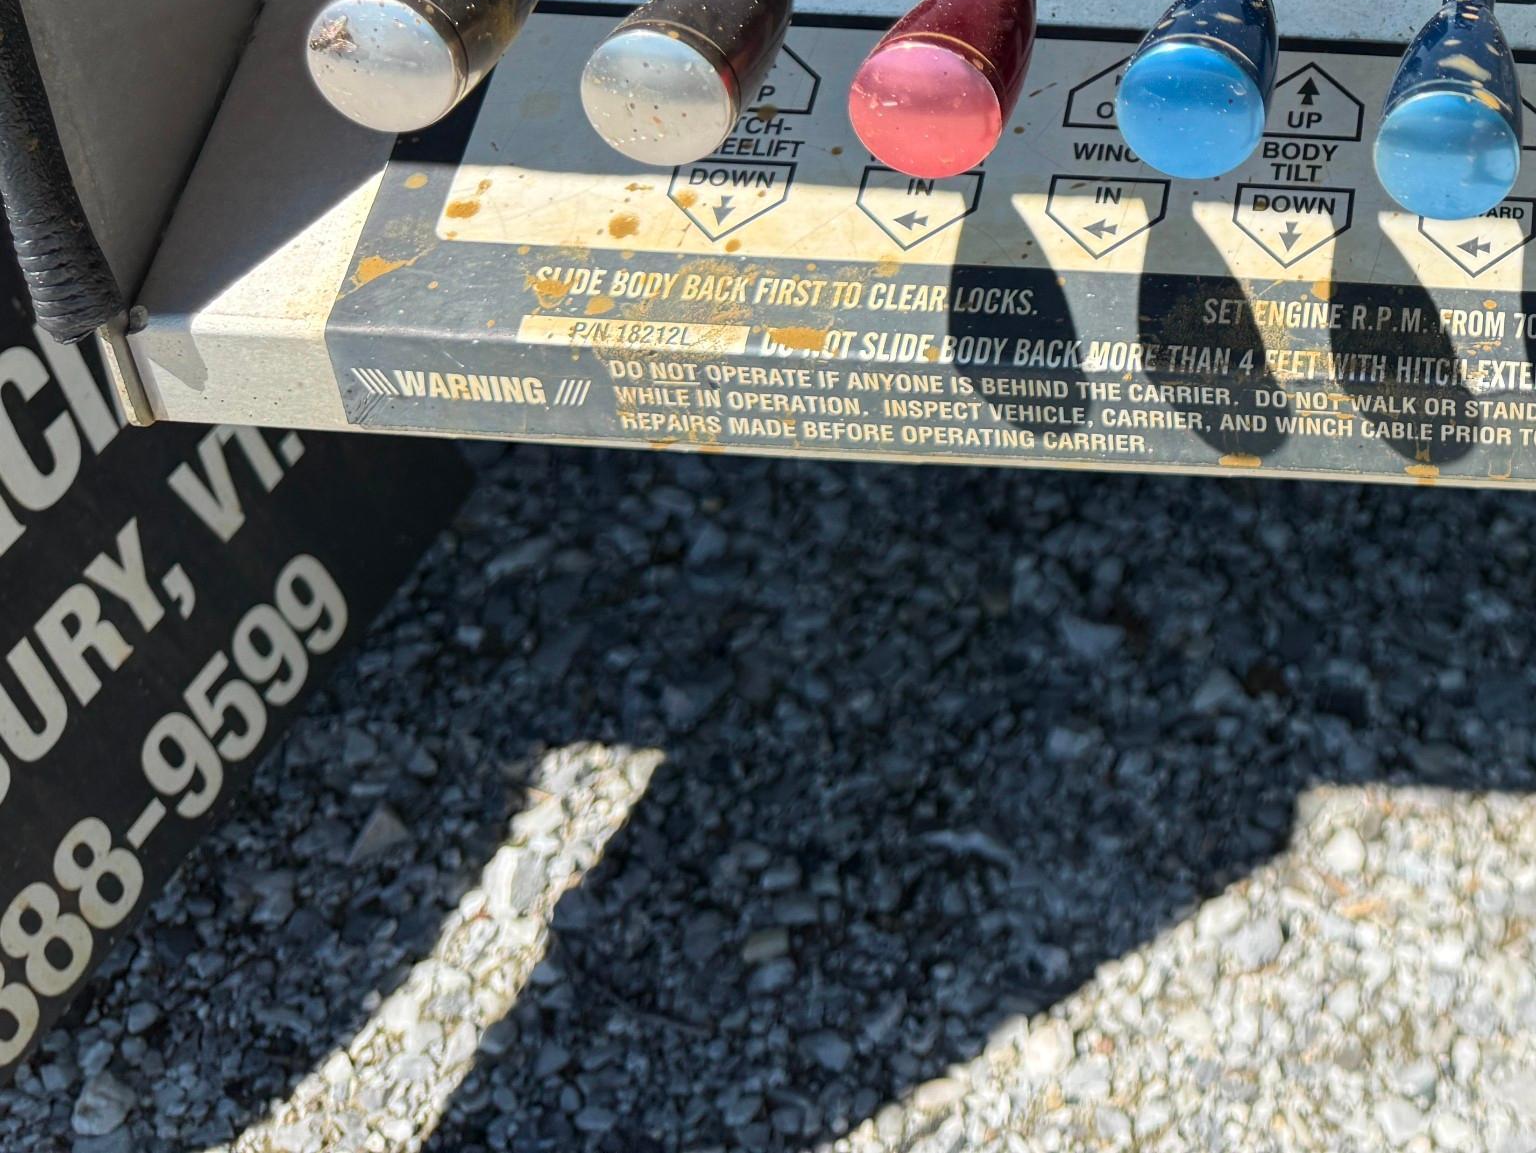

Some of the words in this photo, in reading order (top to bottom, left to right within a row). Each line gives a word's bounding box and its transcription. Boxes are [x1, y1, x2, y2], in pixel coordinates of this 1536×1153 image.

[756, 85, 776, 102] P
[1287, 111, 1323, 129] UP
[713, 137, 806, 158] EELIFT
[1073, 142, 1141, 163] WINC
[1262, 141, 1339, 163] BODY
[688, 167, 776, 190] DOWN
[1270, 162, 1323, 183] TILT
[907, 177, 936, 197] IN
[1095, 186, 1123, 205] IN
[1252, 194, 1337, 216] DOWN
[609, 269, 680, 301] BODY
[682, 274, 750, 303] BACK
[753, 277, 826, 307] FIRST
[830, 281, 865, 309] TO
[868, 283, 947, 313] CLEAR
[953, 286, 1038, 316] LOCKS.
[1203, 298, 1248, 325] SET
[1255, 301, 1342, 330] ENGINE
[1351, 305, 1428, 334] R.P.M.
[1438, 309, 1506, 338] FROM
[617, 323, 690, 346] 18212L
[801, 329, 858, 360] OT
[859, 331, 935, 364] SLIDE
[939, 334, 1007, 366] BODY
[1012, 339, 1082, 370] BACK
[1084, 340, 1167, 374] MORE
[1168, 344, 1231, 376] THAN
[1239, 348, 1255, 377] 4
[1263, 349, 1320, 380] FEET
[1327, 352, 1386, 384] WITH
[1395, 356, 1468, 388] HITCH
[391, 369, 547, 405] WARNING
[609, 359, 643, 380] DO
[653, 362, 701, 384] NOT
[706, 364, 812, 389] OPERATE
[819, 369, 840, 390] IF
[847, 371, 945, 395] ANYONE
[952, 376, 975, 395] IS
[982, 378, 1069, 399] BEHIND
[1076, 381, 1121, 403] THE
[1128, 384, 1240, 407] CARRIER.
[1256, 389, 1288, 410] DO
[1295, 391, 1343, 415] NOT
[1350, 394, 1417, 416] WALK
[1423, 397, 1457, 417] OR
[614, 386, 692, 408] WHILE
[699, 390, 722, 410] IN
[729, 392, 869, 418] OPERATION.
[884, 399, 982, 422] INSPECT
[989, 403, 1094, 429] VEHICLE,
[1101, 408, 1212, 434] CARRIER,
[1219, 414, 1268, 433] AND
[1276, 416, 1354, 438] WINCH
[1360, 420, 1433, 442] CABLE
[1440, 424, 1512, 446] PRIOR
[621, 412, 722, 435] REPAIRS
[729, 416, 797, 438] MADE
[803, 420, 895, 444] BEFORE
[901, 426, 1035, 451] OPERATING
[1043, 431, 1154, 455] CARRIER.
[0, 516, 196, 805] URY,
